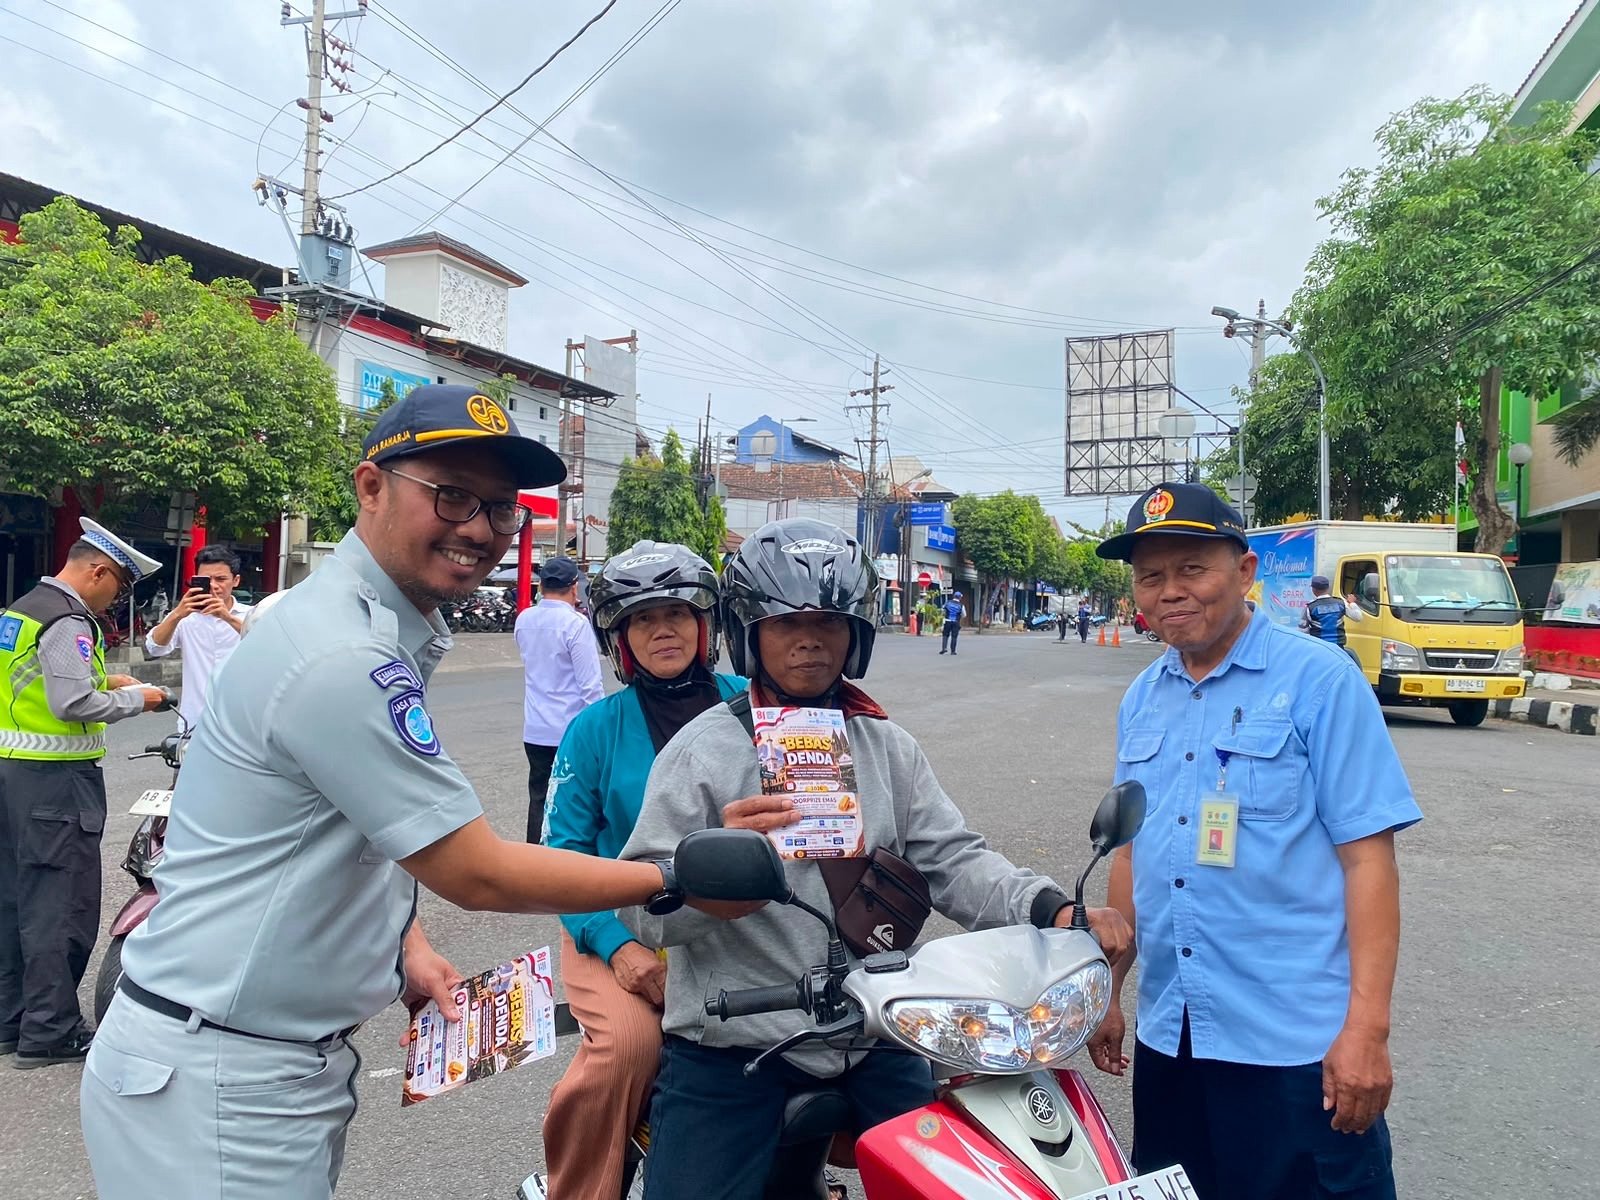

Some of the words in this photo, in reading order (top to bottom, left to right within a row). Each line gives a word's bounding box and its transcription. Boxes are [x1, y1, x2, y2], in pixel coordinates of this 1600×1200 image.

[380, 430, 411, 451] RAHARJA
[786, 752, 834, 766] DENDA
[494, 993, 507, 1047] DENDA
